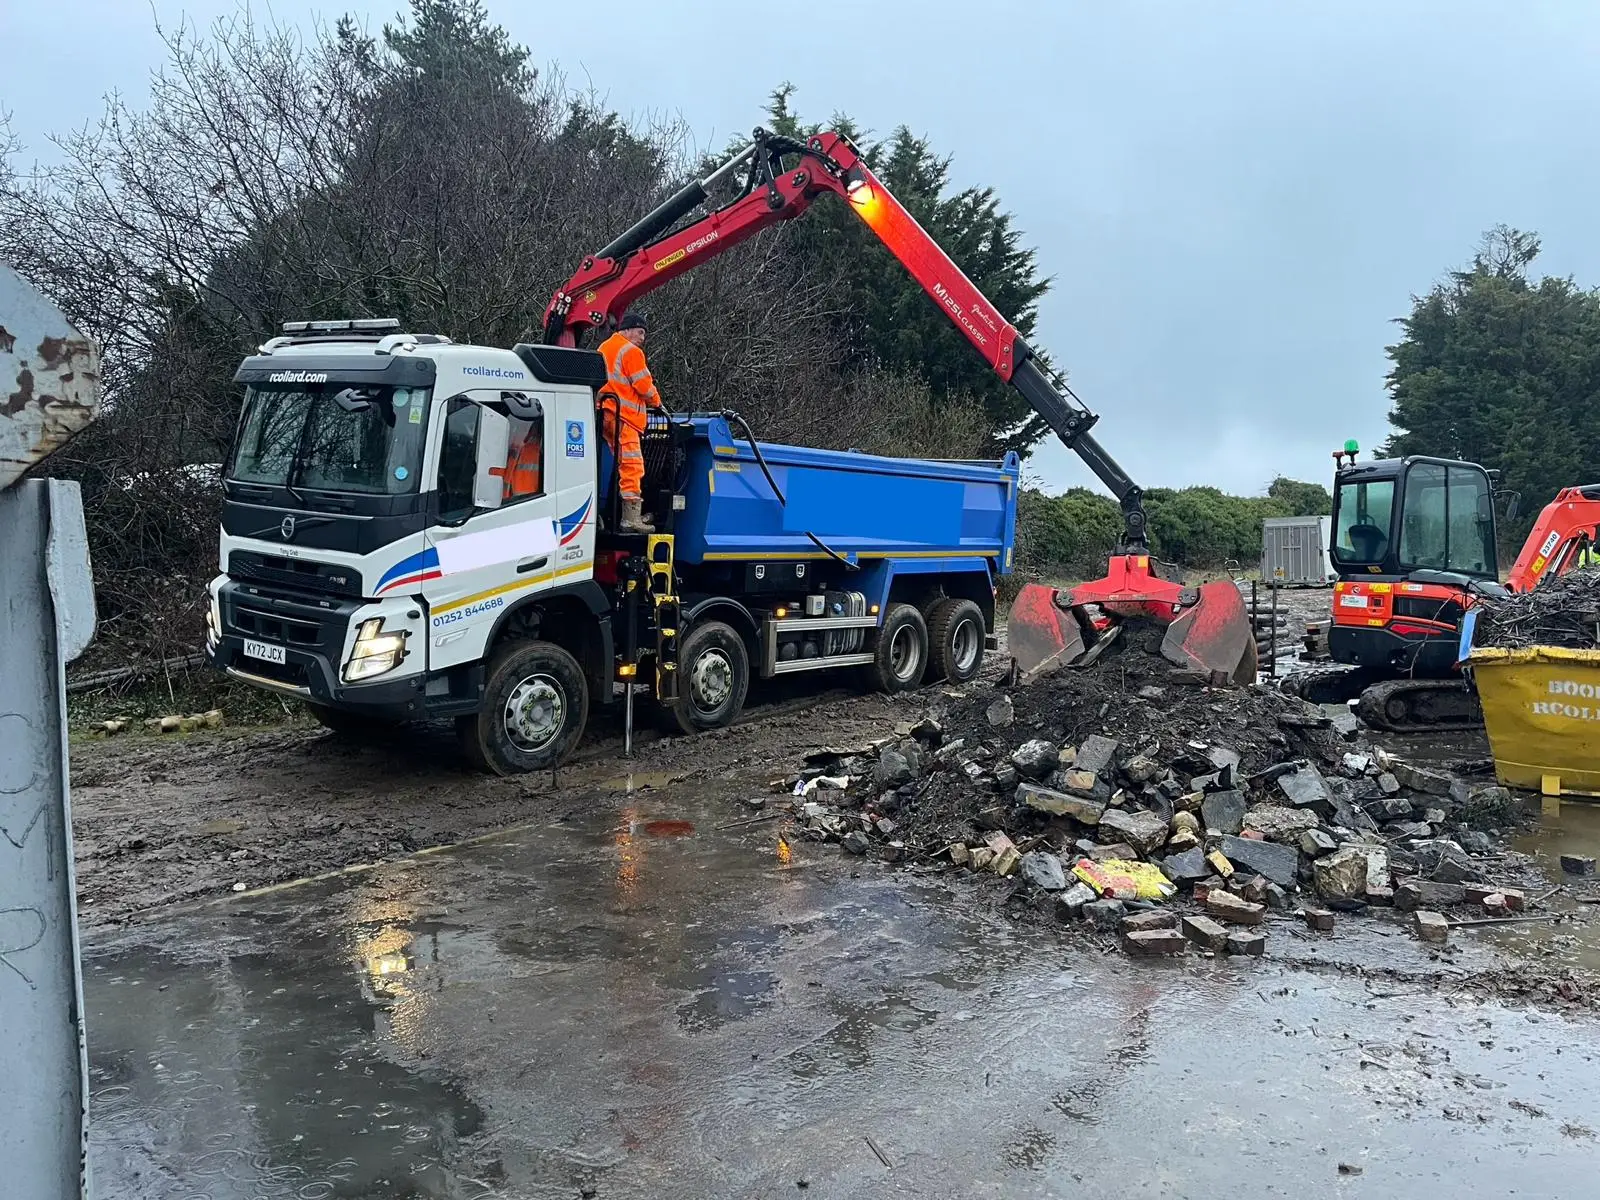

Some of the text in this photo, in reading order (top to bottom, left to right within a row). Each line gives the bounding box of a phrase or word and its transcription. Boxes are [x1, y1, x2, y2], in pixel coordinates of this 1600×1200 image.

[686, 230, 719, 253] EPSILON
[961, 317, 987, 345] CLASSIC
[269, 370, 328, 382] rcollard.com
[463, 366, 524, 379] rcollard.com
[567, 444, 584, 452] FORS
[562, 550, 583, 560] 420
[433, 597, 503, 627] 01252 844688
[247, 642, 282, 661] KY72 JCX
[1532, 702, 1600, 720] RCOL
